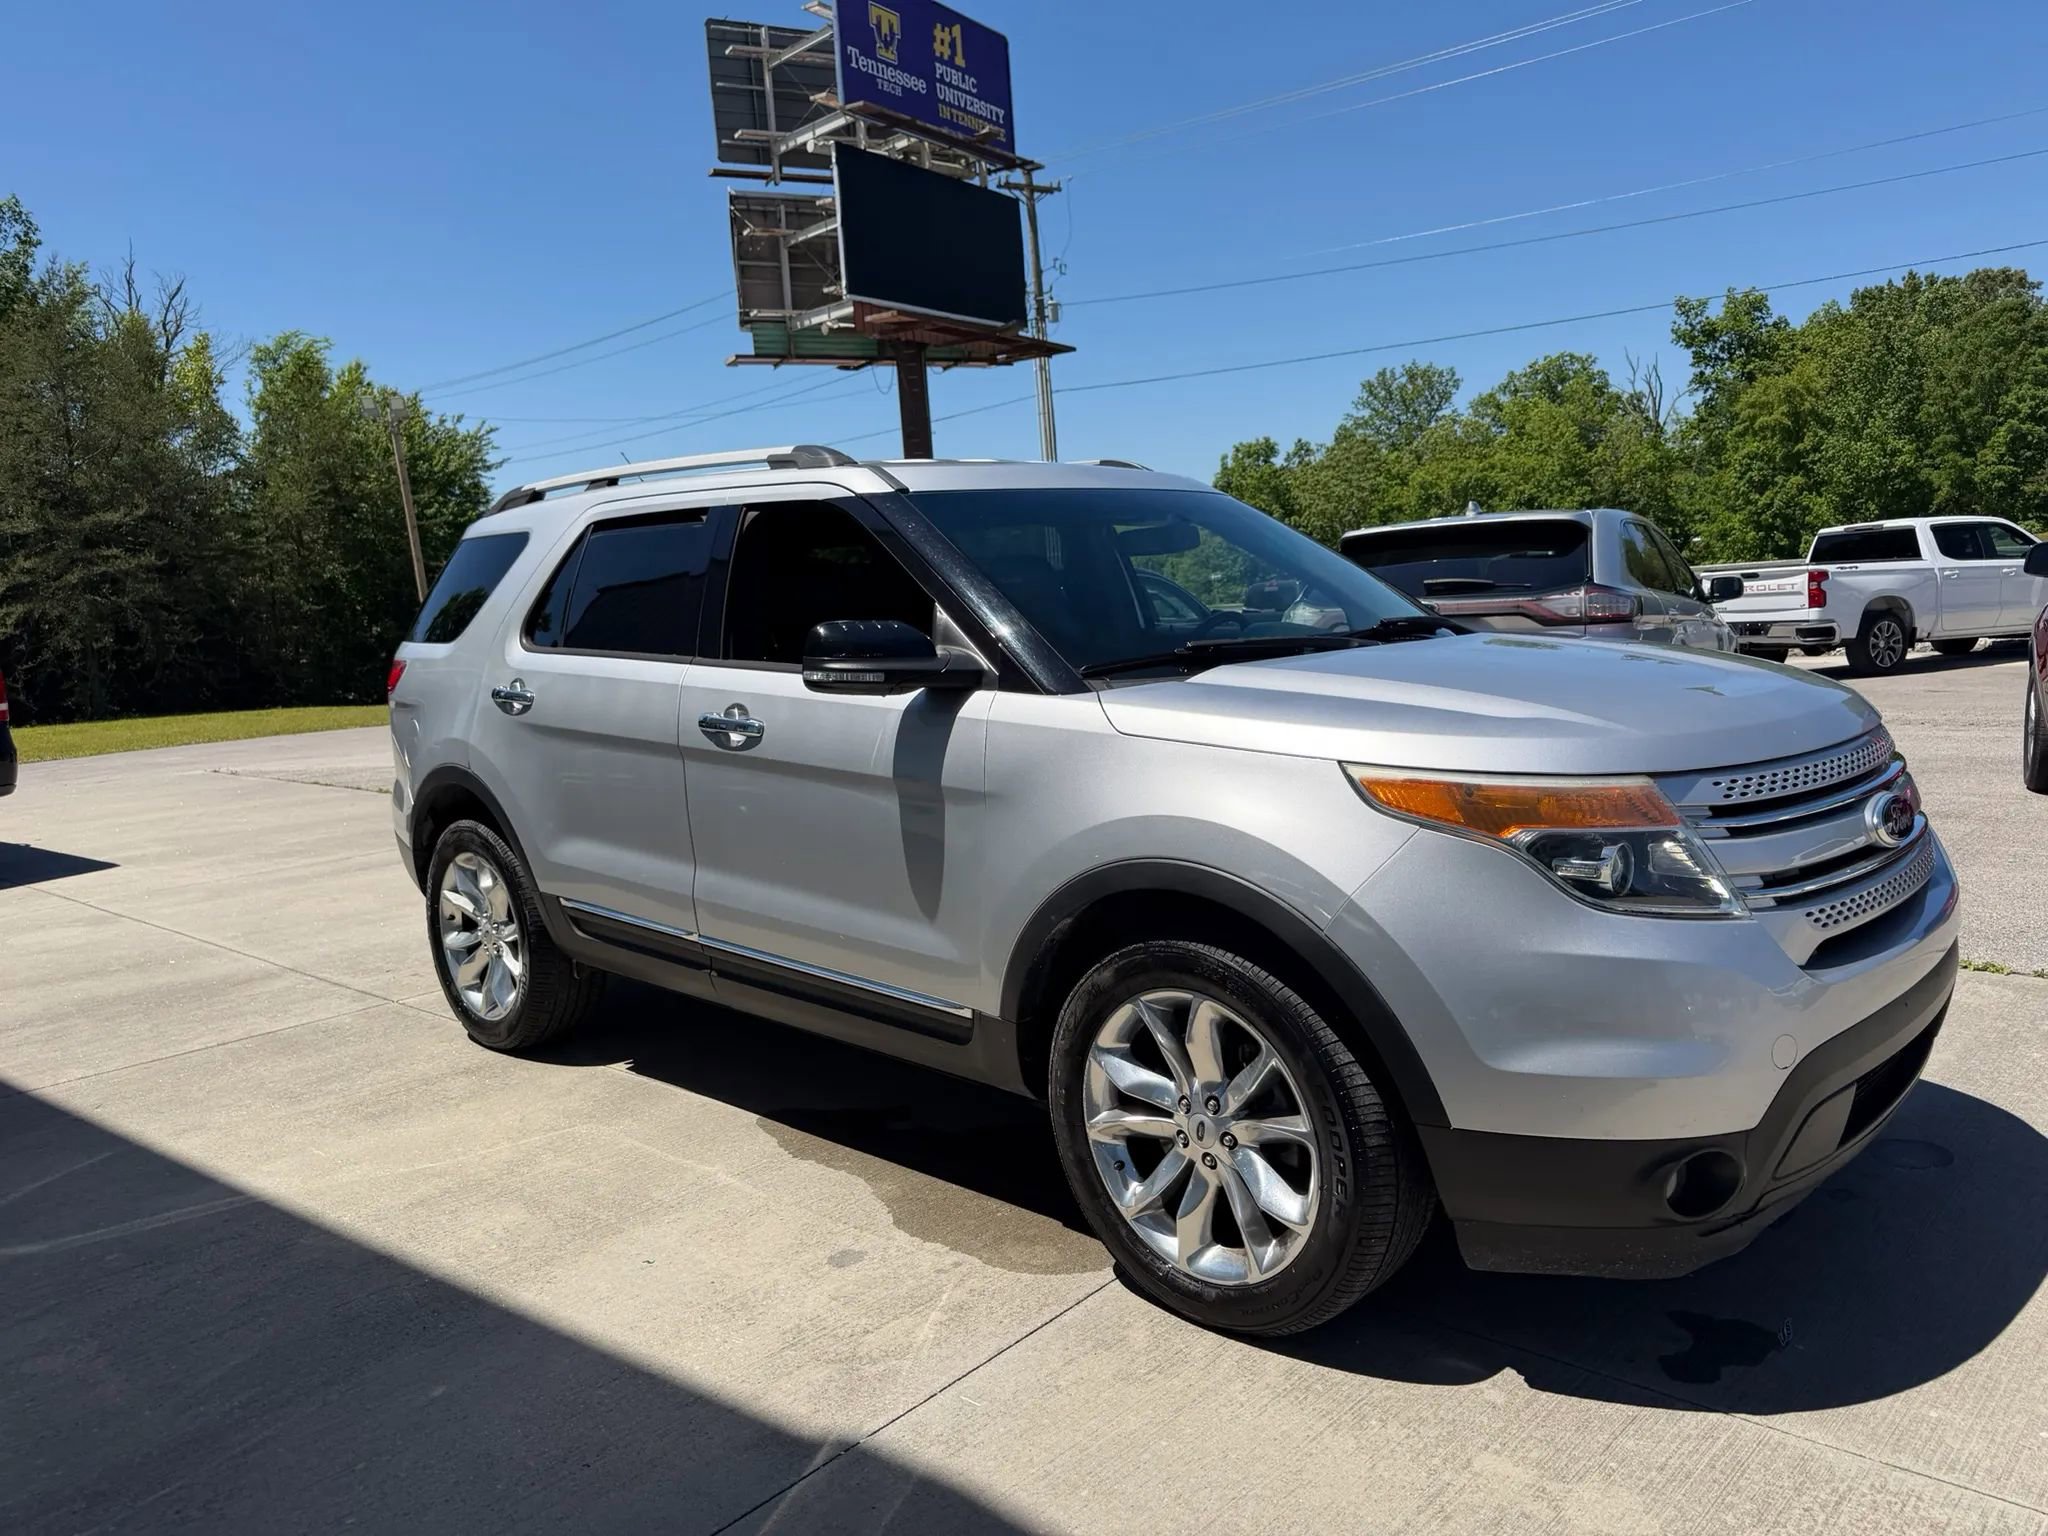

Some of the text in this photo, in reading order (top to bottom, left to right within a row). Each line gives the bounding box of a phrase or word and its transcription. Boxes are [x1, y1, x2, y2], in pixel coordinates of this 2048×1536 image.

[933, 22, 966, 68] #1
[847, 45, 927, 94] Tennessee
[935, 62, 978, 94] PUBLIC
[876, 78, 902, 97] TECH
[936, 82, 1005, 124] UNIVERSITY
[938, 103, 951, 120] IN
[1744, 583, 1798, 592] ROLET
